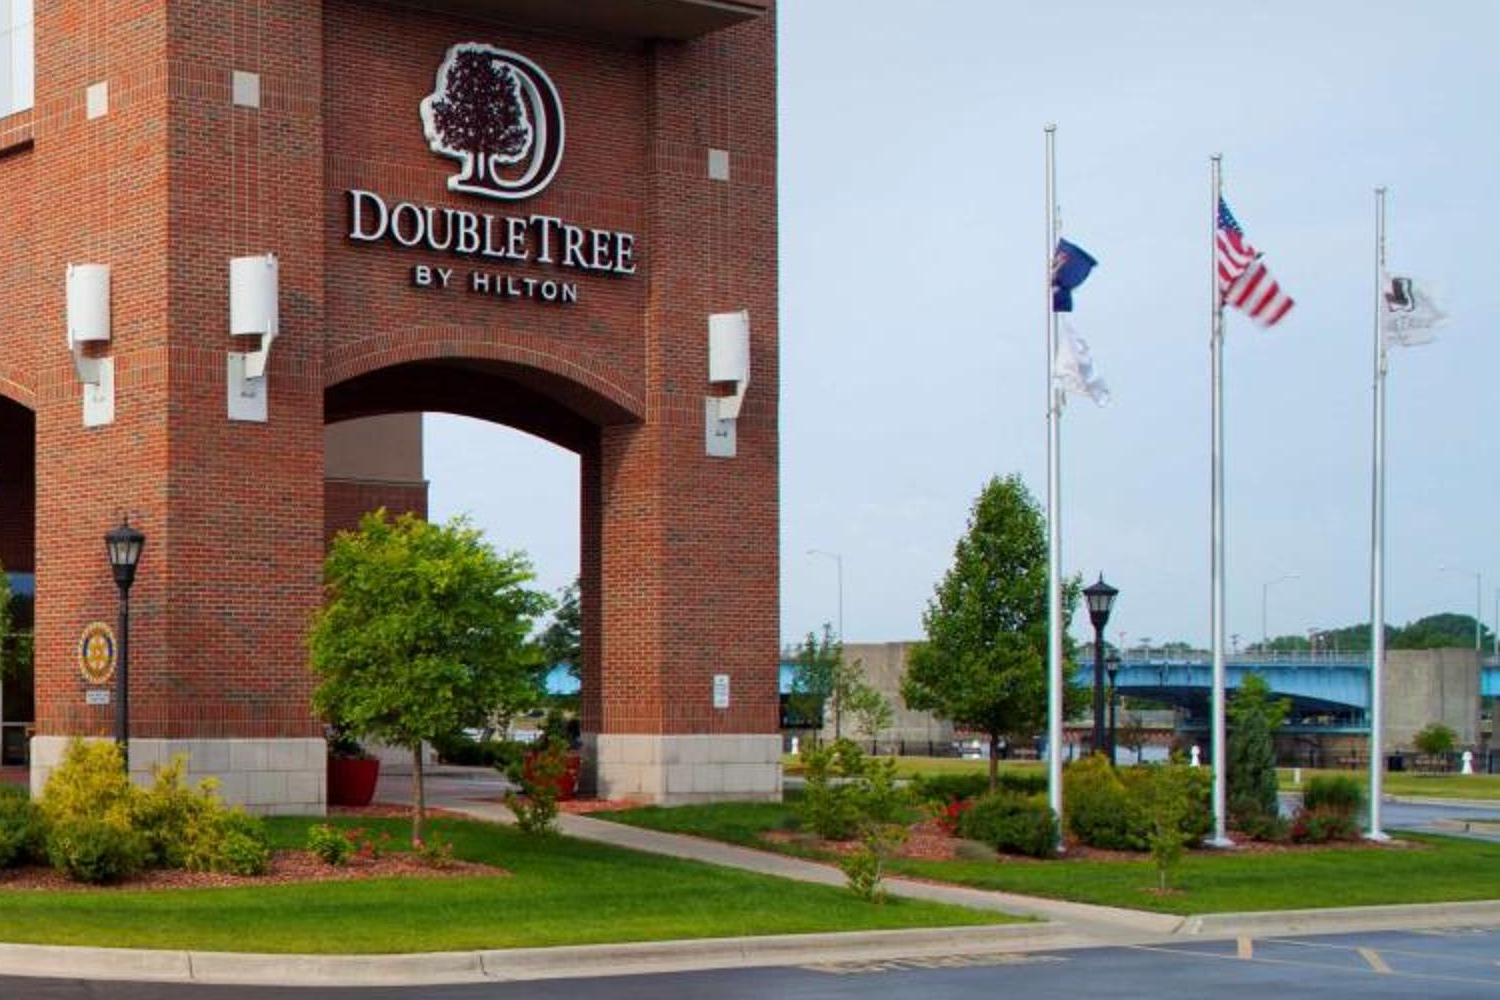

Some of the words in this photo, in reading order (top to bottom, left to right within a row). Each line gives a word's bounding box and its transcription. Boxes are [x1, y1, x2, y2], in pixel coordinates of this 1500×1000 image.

[349, 189, 636, 273] DOUBLETREE
[414, 265, 453, 288] BY
[473, 272, 578, 302] HILTON
